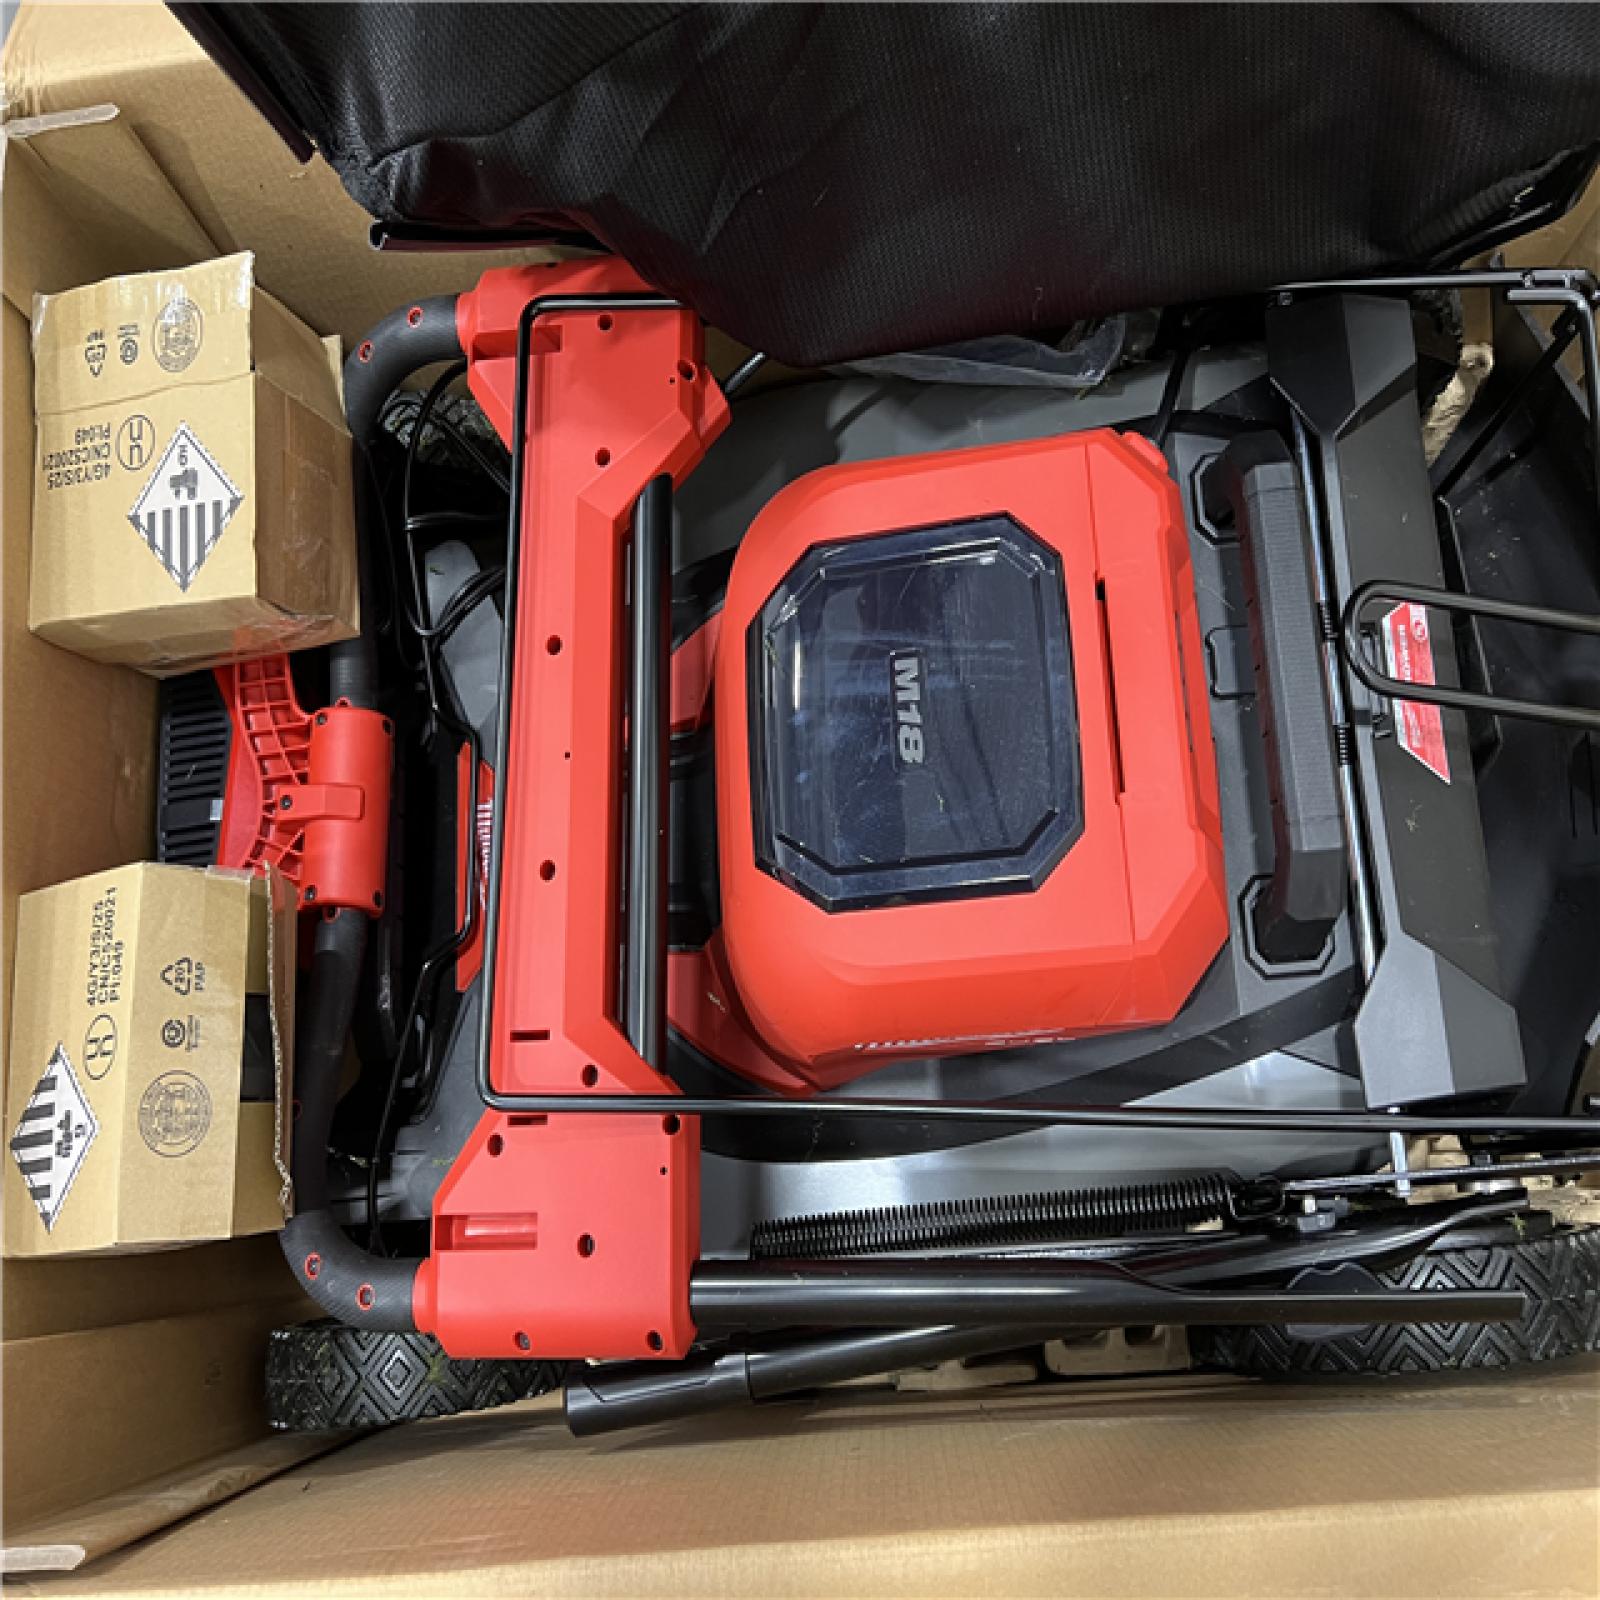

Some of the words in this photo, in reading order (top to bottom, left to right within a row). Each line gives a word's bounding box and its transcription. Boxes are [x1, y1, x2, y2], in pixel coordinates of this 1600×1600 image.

[895, 657, 924, 763] M18
[87, 899, 104, 1006] 4G/Y3/S/25
[97, 886, 117, 1005] CN/C520021
[194, 961, 205, 991] PAP
